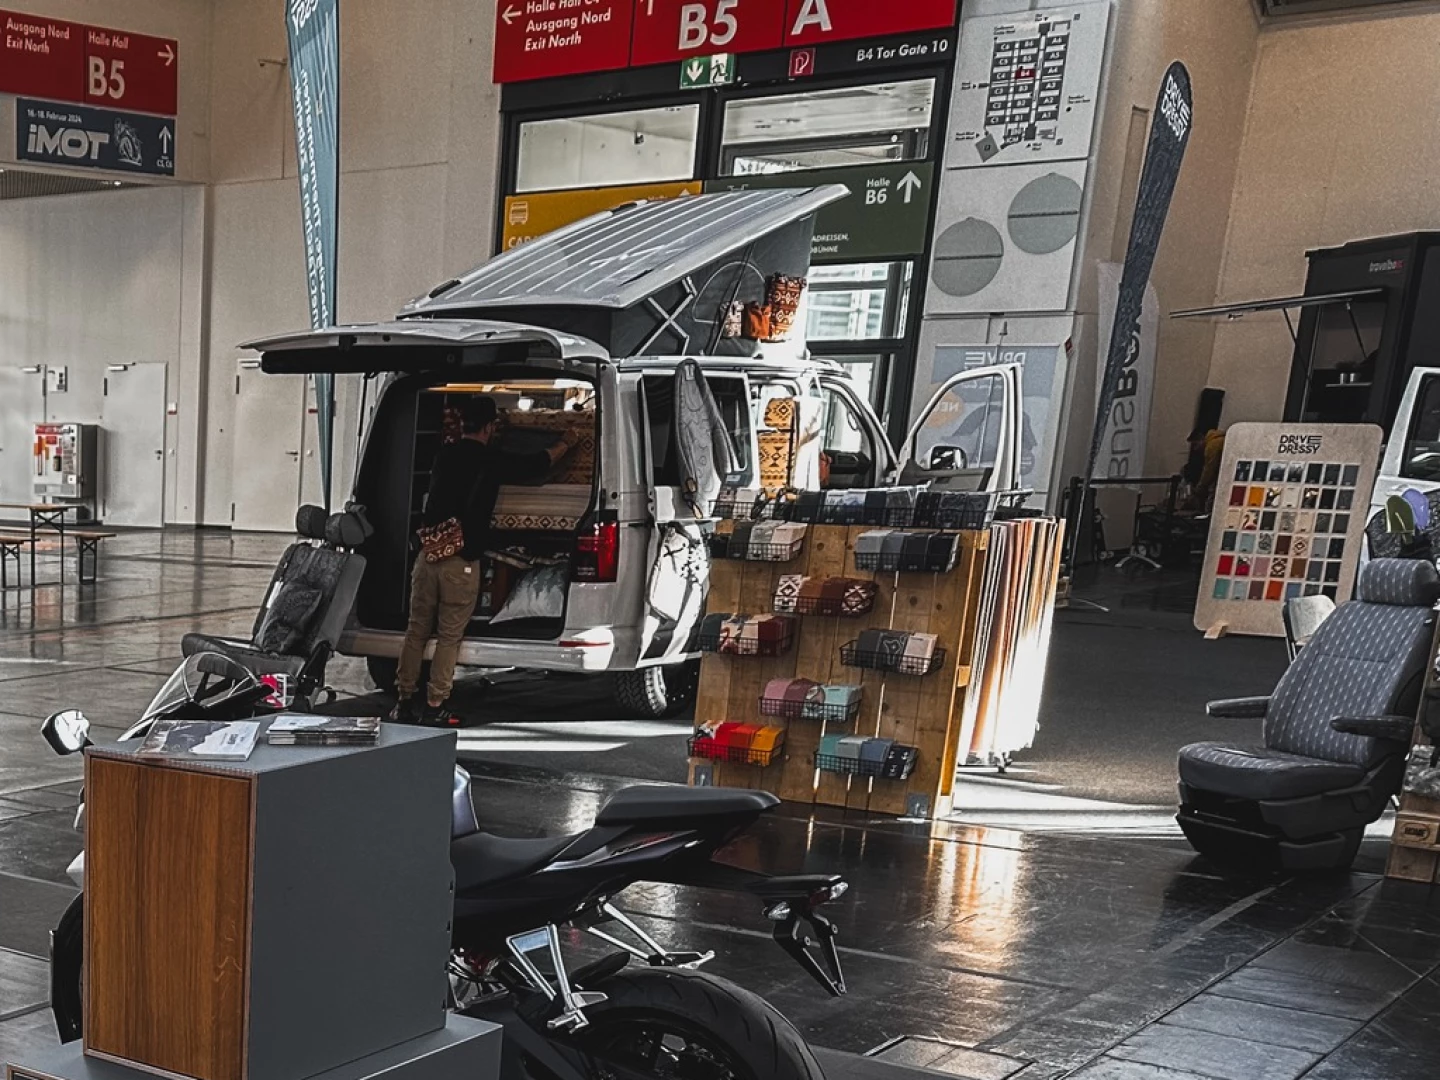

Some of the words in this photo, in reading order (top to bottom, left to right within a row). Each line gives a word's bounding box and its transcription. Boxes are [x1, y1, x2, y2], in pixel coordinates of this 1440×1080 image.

[526, 1, 556, 14] Halle
[791, 0, 833, 35] A
[6, 17, 46, 39] Ausgang
[48, 25, 70, 40] Nord
[525, 17, 579, 33] Ausgang
[581, 7, 612, 25] Nord
[678, 0, 738, 50] B5
[6, 35, 23, 49] Exit
[24, 38, 50, 54] North
[88, 31, 110, 46] Halle
[112, 35, 128, 50] Hall
[524, 37, 546, 52] Exit
[548, 31, 582, 49] North
[857, 48, 873, 62] B4
[877, 47, 896, 60] Tor
[899, 44, 928, 57] Gate
[932, 39, 949, 53] 10
[88, 55, 126, 99] B5
[27, 123, 110, 160] iMOT
[866, 177, 891, 188] Halle
[865, 188, 888, 205] B6
